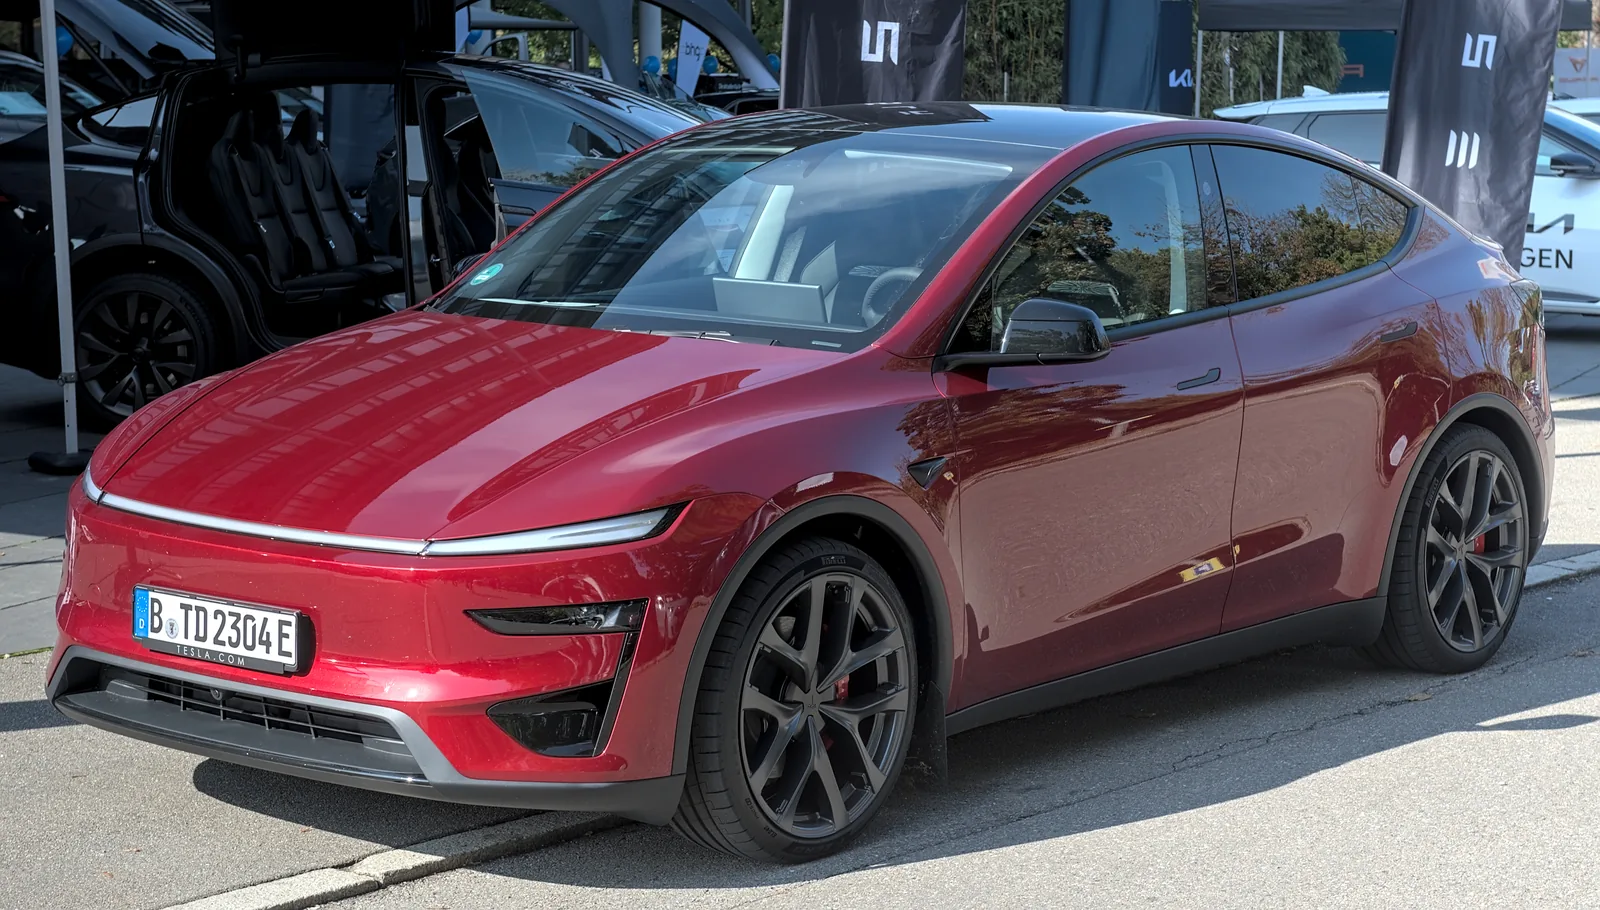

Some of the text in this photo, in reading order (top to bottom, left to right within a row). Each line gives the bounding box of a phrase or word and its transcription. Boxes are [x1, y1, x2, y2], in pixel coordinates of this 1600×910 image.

[1520, 247, 1573, 270] GEN
[138, 617, 145, 629] D
[176, 644, 245, 666] TESLA.COM
